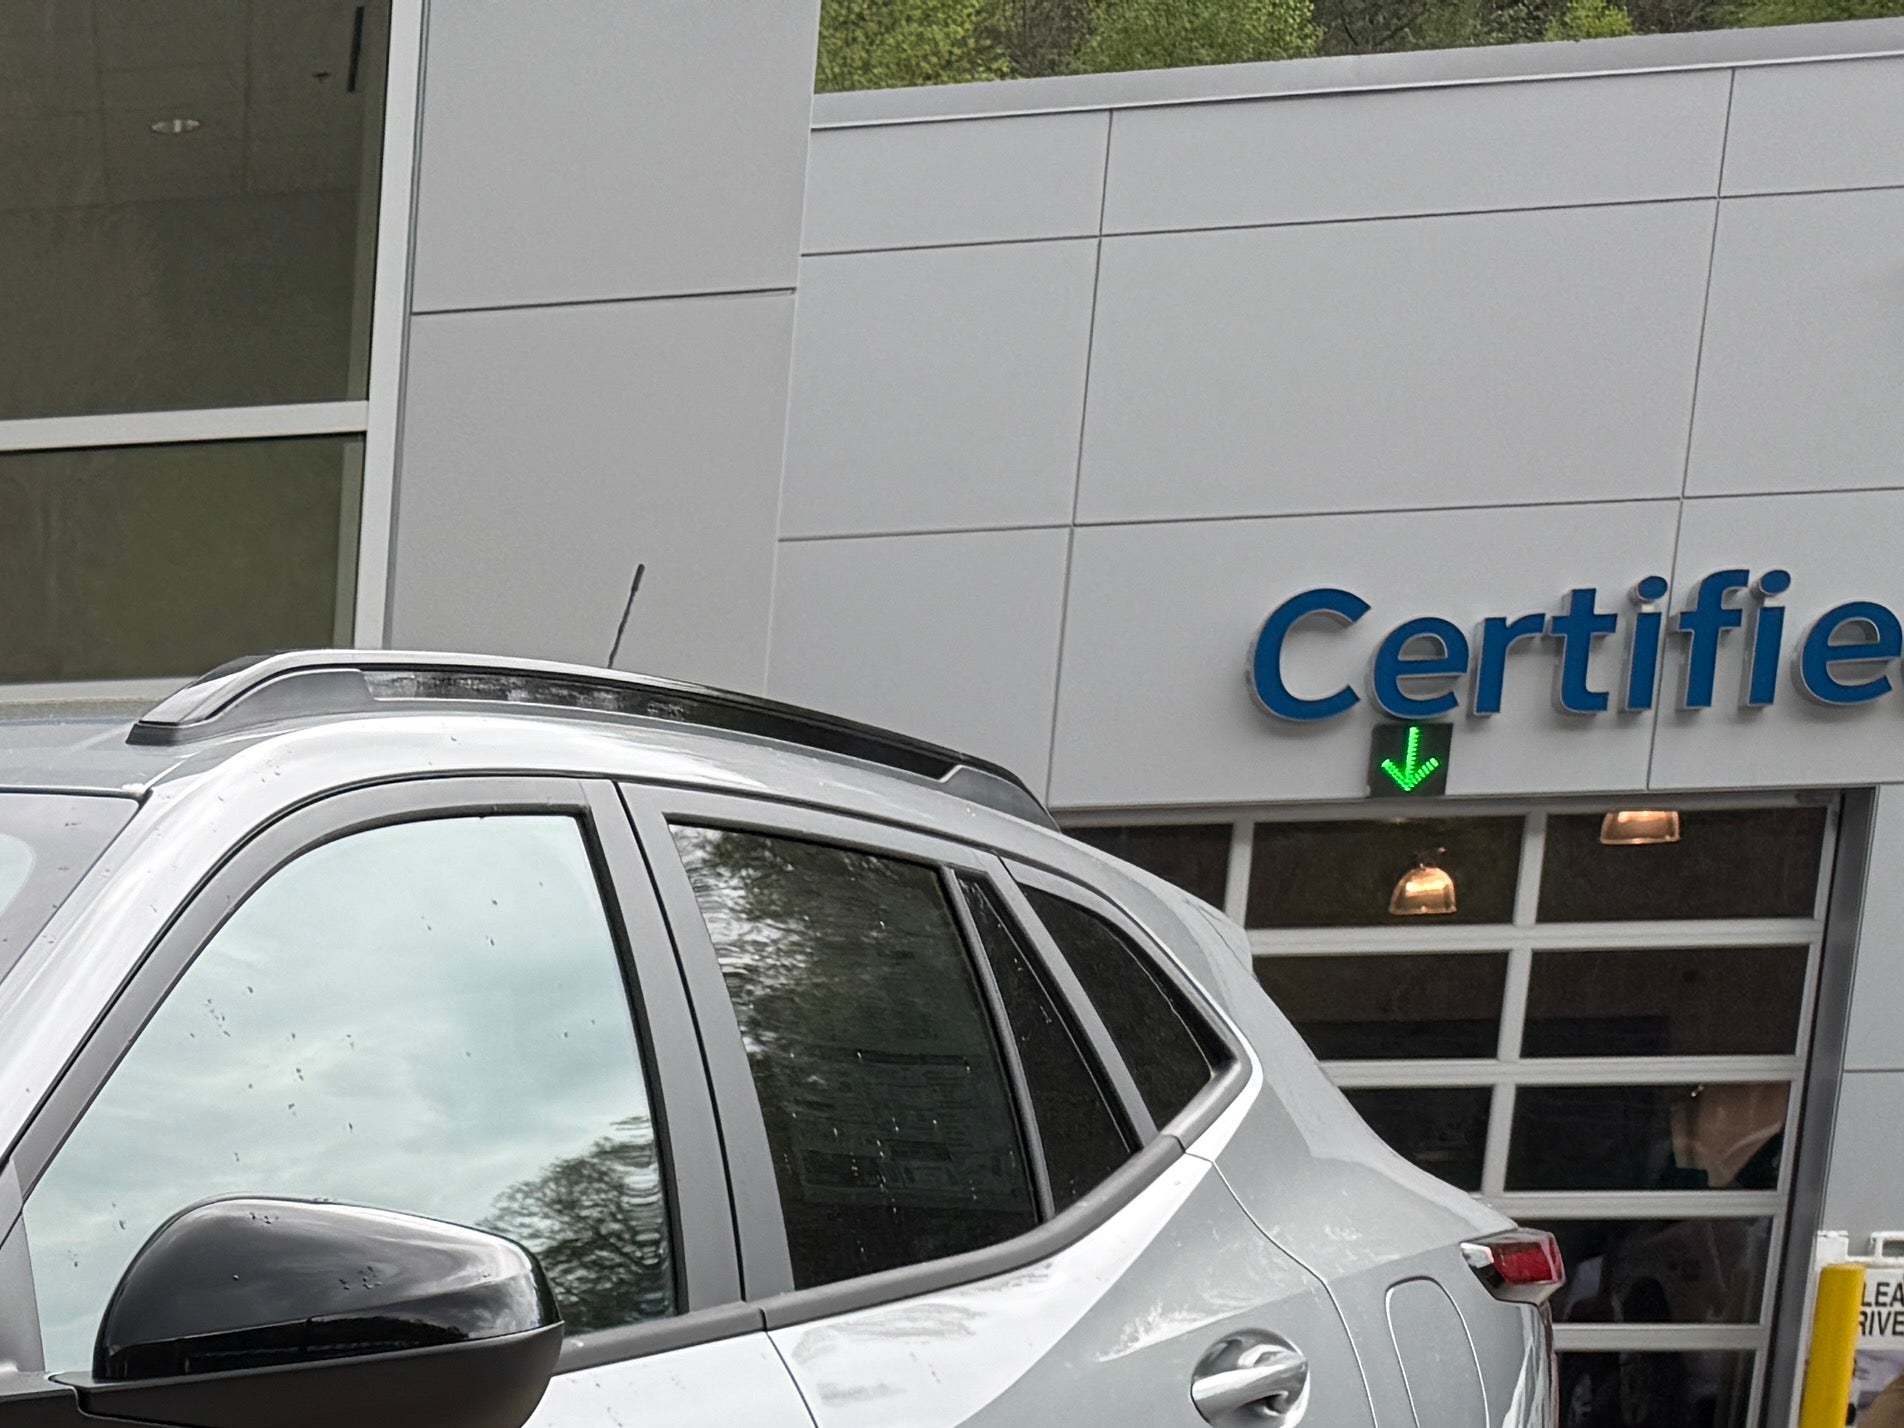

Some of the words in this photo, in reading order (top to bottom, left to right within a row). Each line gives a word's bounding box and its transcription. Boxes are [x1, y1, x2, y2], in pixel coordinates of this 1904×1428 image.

[1249, 568, 1904, 723] Certifie
[1859, 1280, 1904, 1308] LEA
[1858, 1309, 1904, 1337] RIVE
